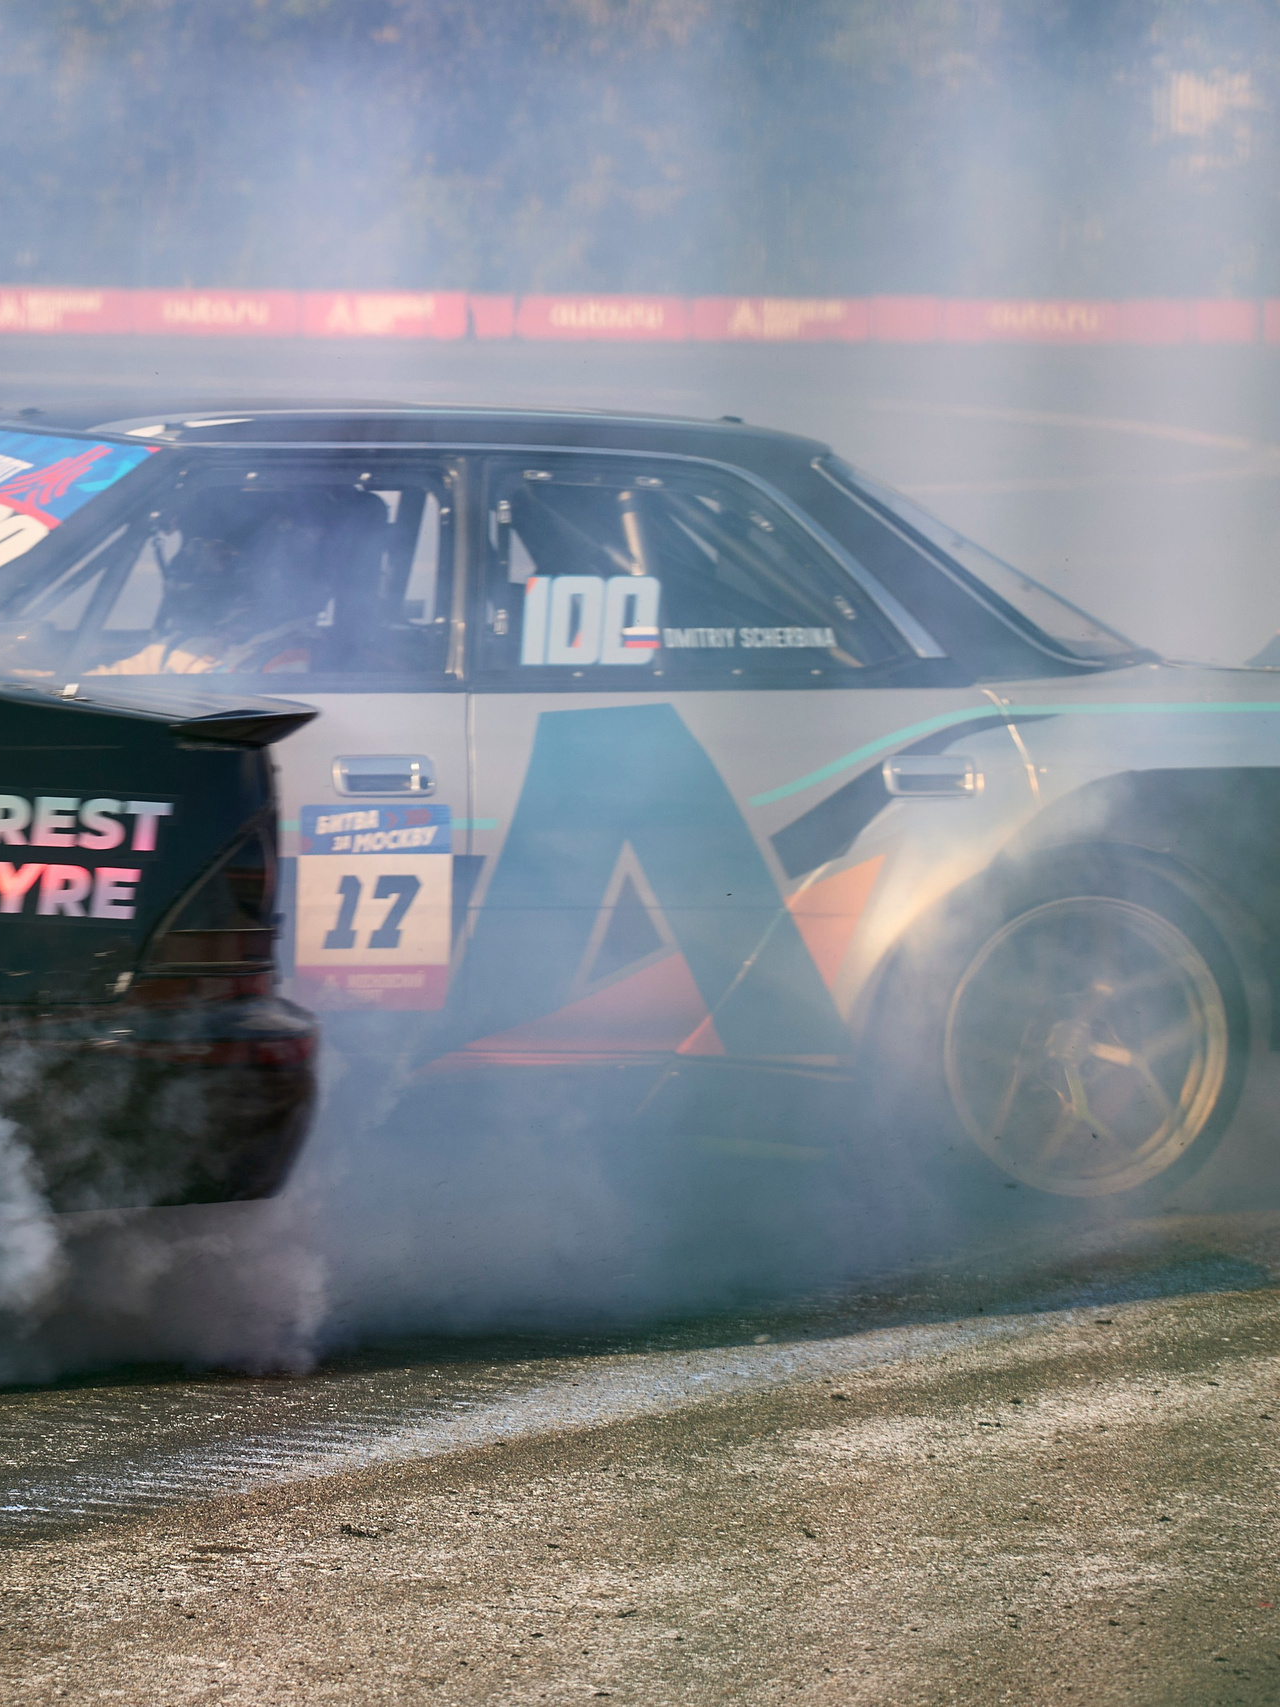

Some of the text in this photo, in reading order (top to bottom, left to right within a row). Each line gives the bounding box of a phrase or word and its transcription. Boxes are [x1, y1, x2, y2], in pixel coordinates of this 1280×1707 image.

[520, 574, 661, 666] 100
[739, 627, 838, 648] SCHERBINA
[352, 826, 438, 852] МОСКВУ
[322, 875, 421, 949] 17
